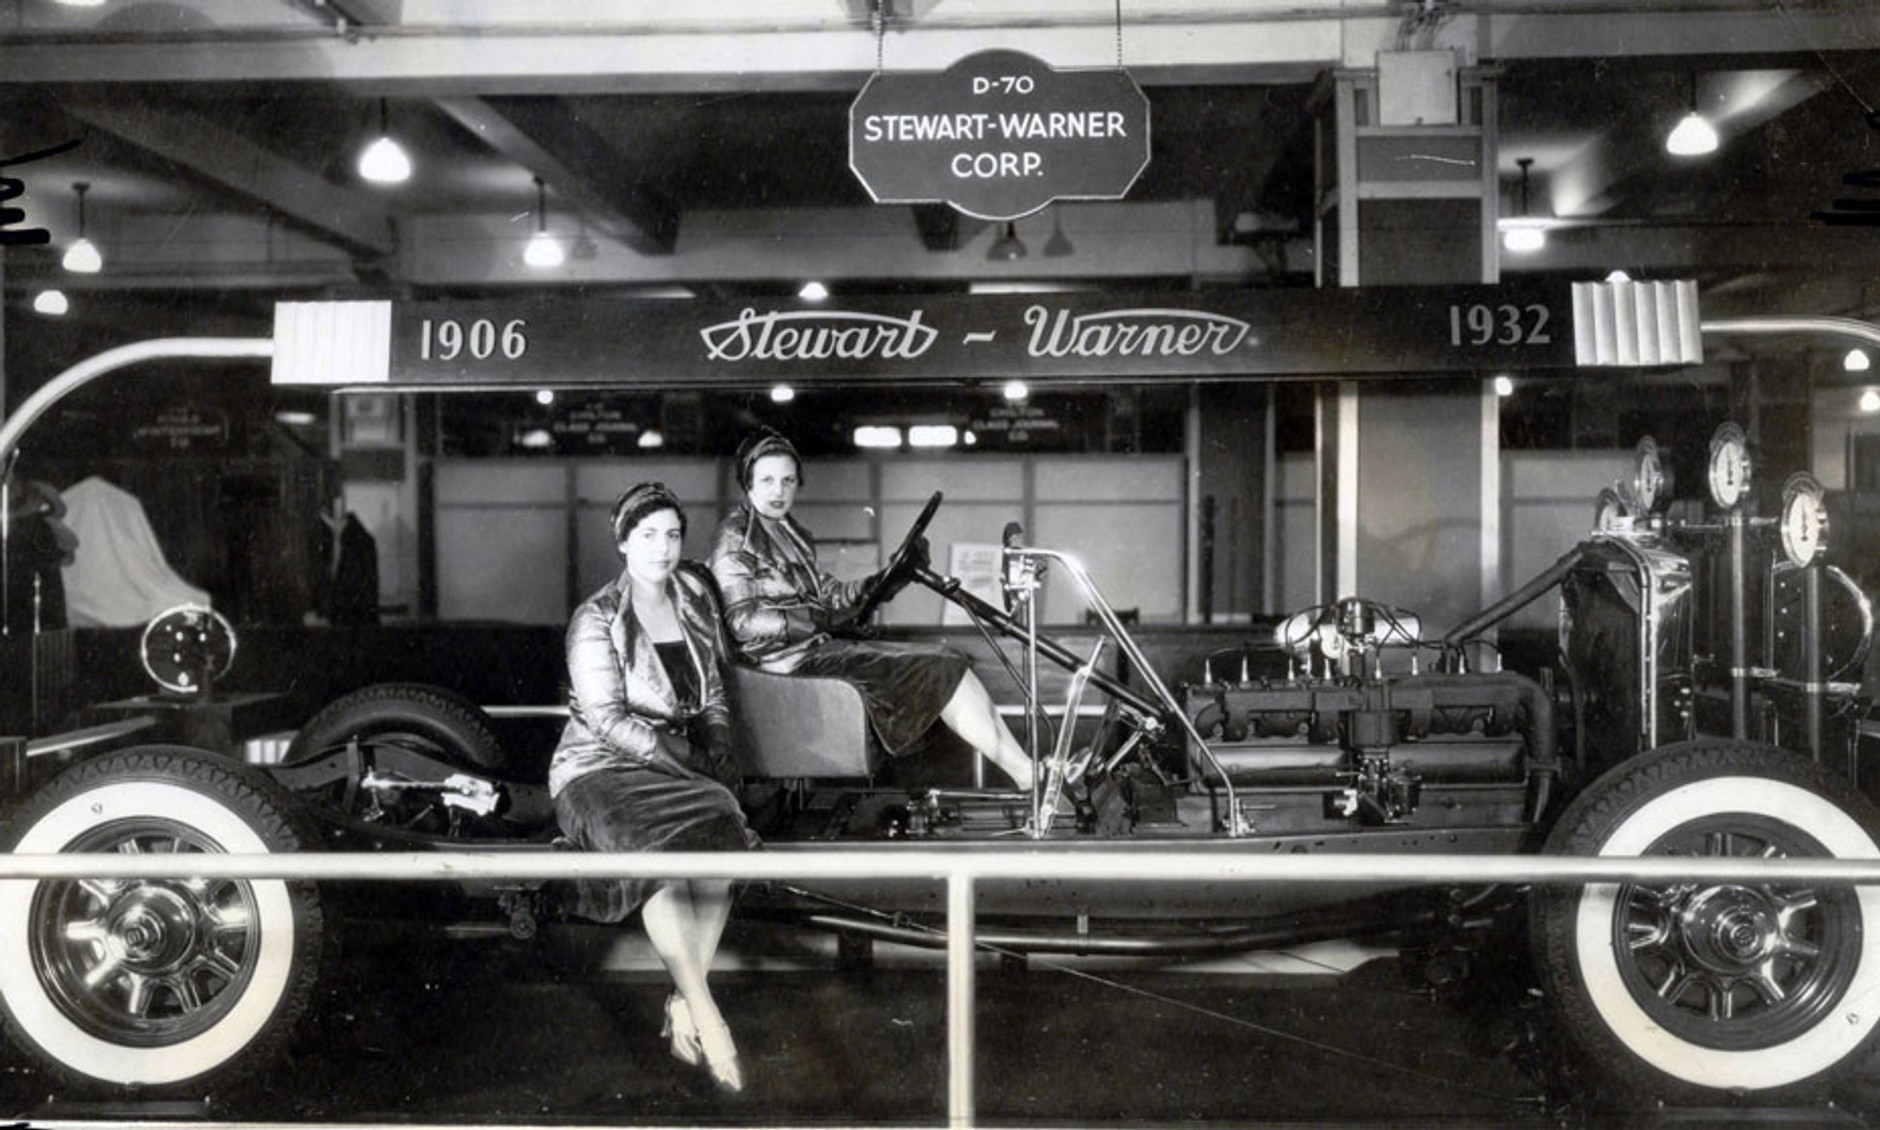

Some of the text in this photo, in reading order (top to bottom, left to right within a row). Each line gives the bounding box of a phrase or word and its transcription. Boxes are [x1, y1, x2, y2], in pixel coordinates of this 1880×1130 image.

[972, 76, 1035, 94] D-70
[864, 112, 1127, 141] STEWART-WARNER
[951, 152, 1044, 178] CORP.
[421, 319, 526, 360] 1906
[700, 307, 938, 361] Stewart
[1023, 305, 1251, 358] Warner
[1450, 304, 1551, 346] 1932
